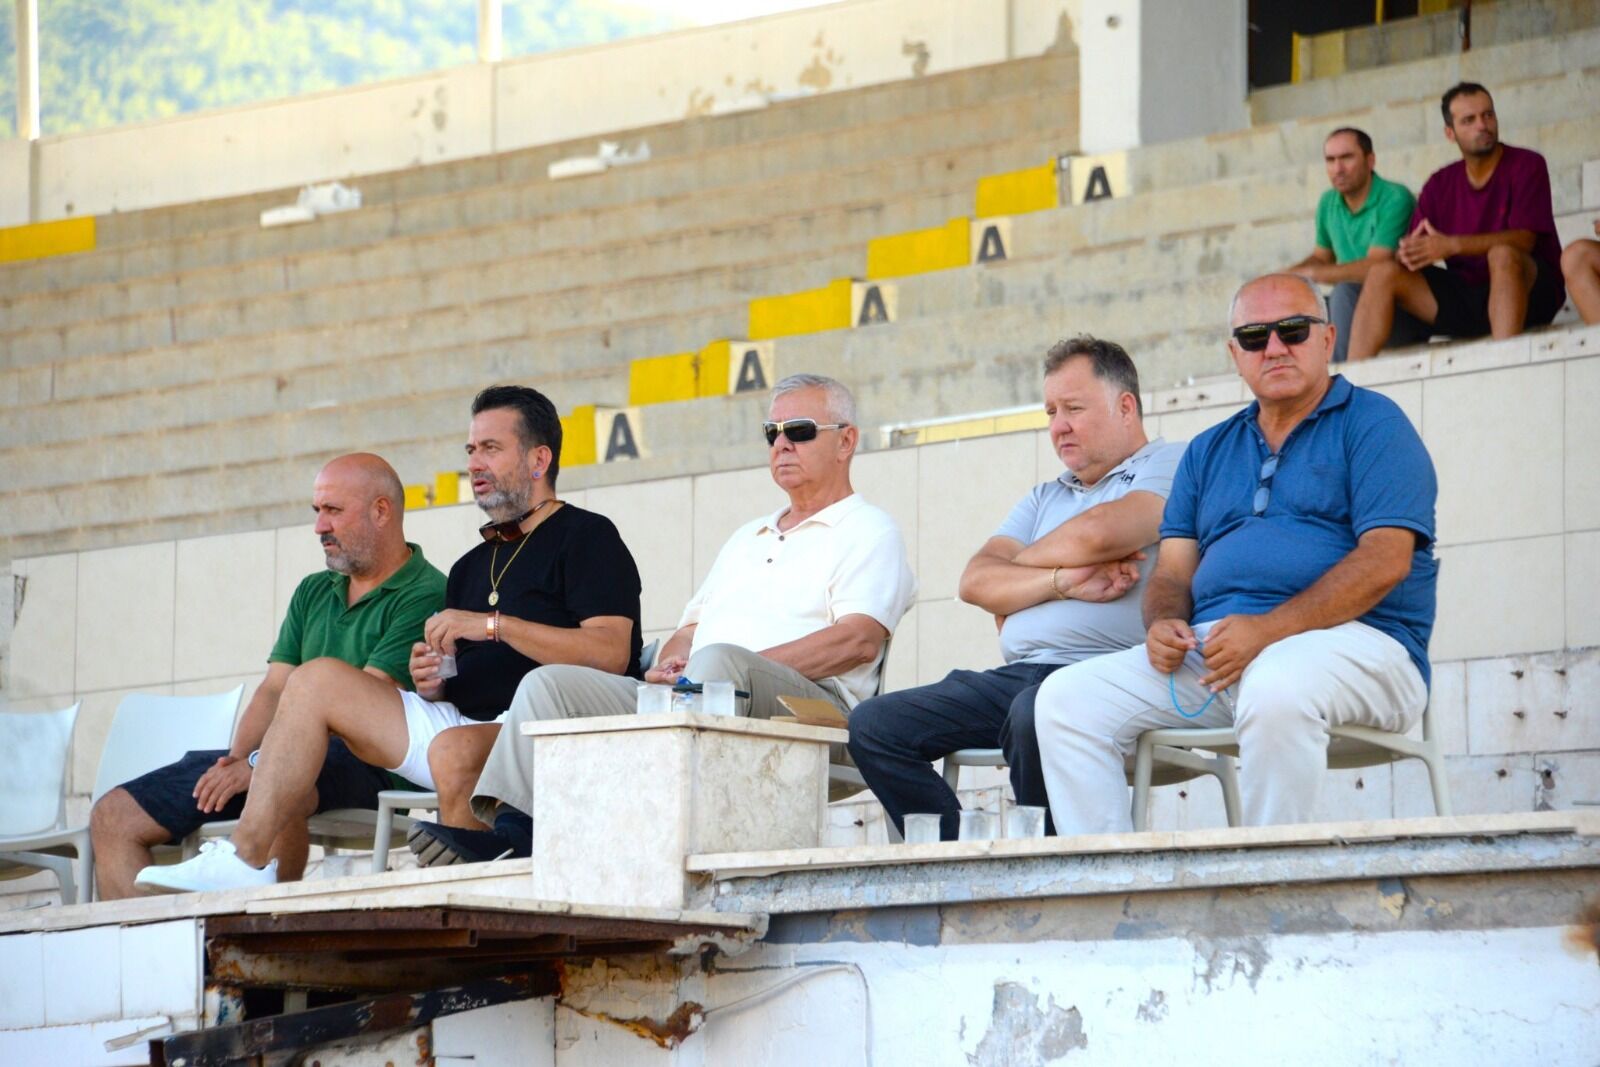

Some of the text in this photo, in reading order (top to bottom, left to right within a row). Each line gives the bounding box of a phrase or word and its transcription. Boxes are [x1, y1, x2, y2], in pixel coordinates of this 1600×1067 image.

[1084, 166, 1112, 203] A
[977, 225, 1006, 263] A
[858, 286, 888, 326] A
[735, 350, 767, 393] A
[604, 413, 639, 463] A
